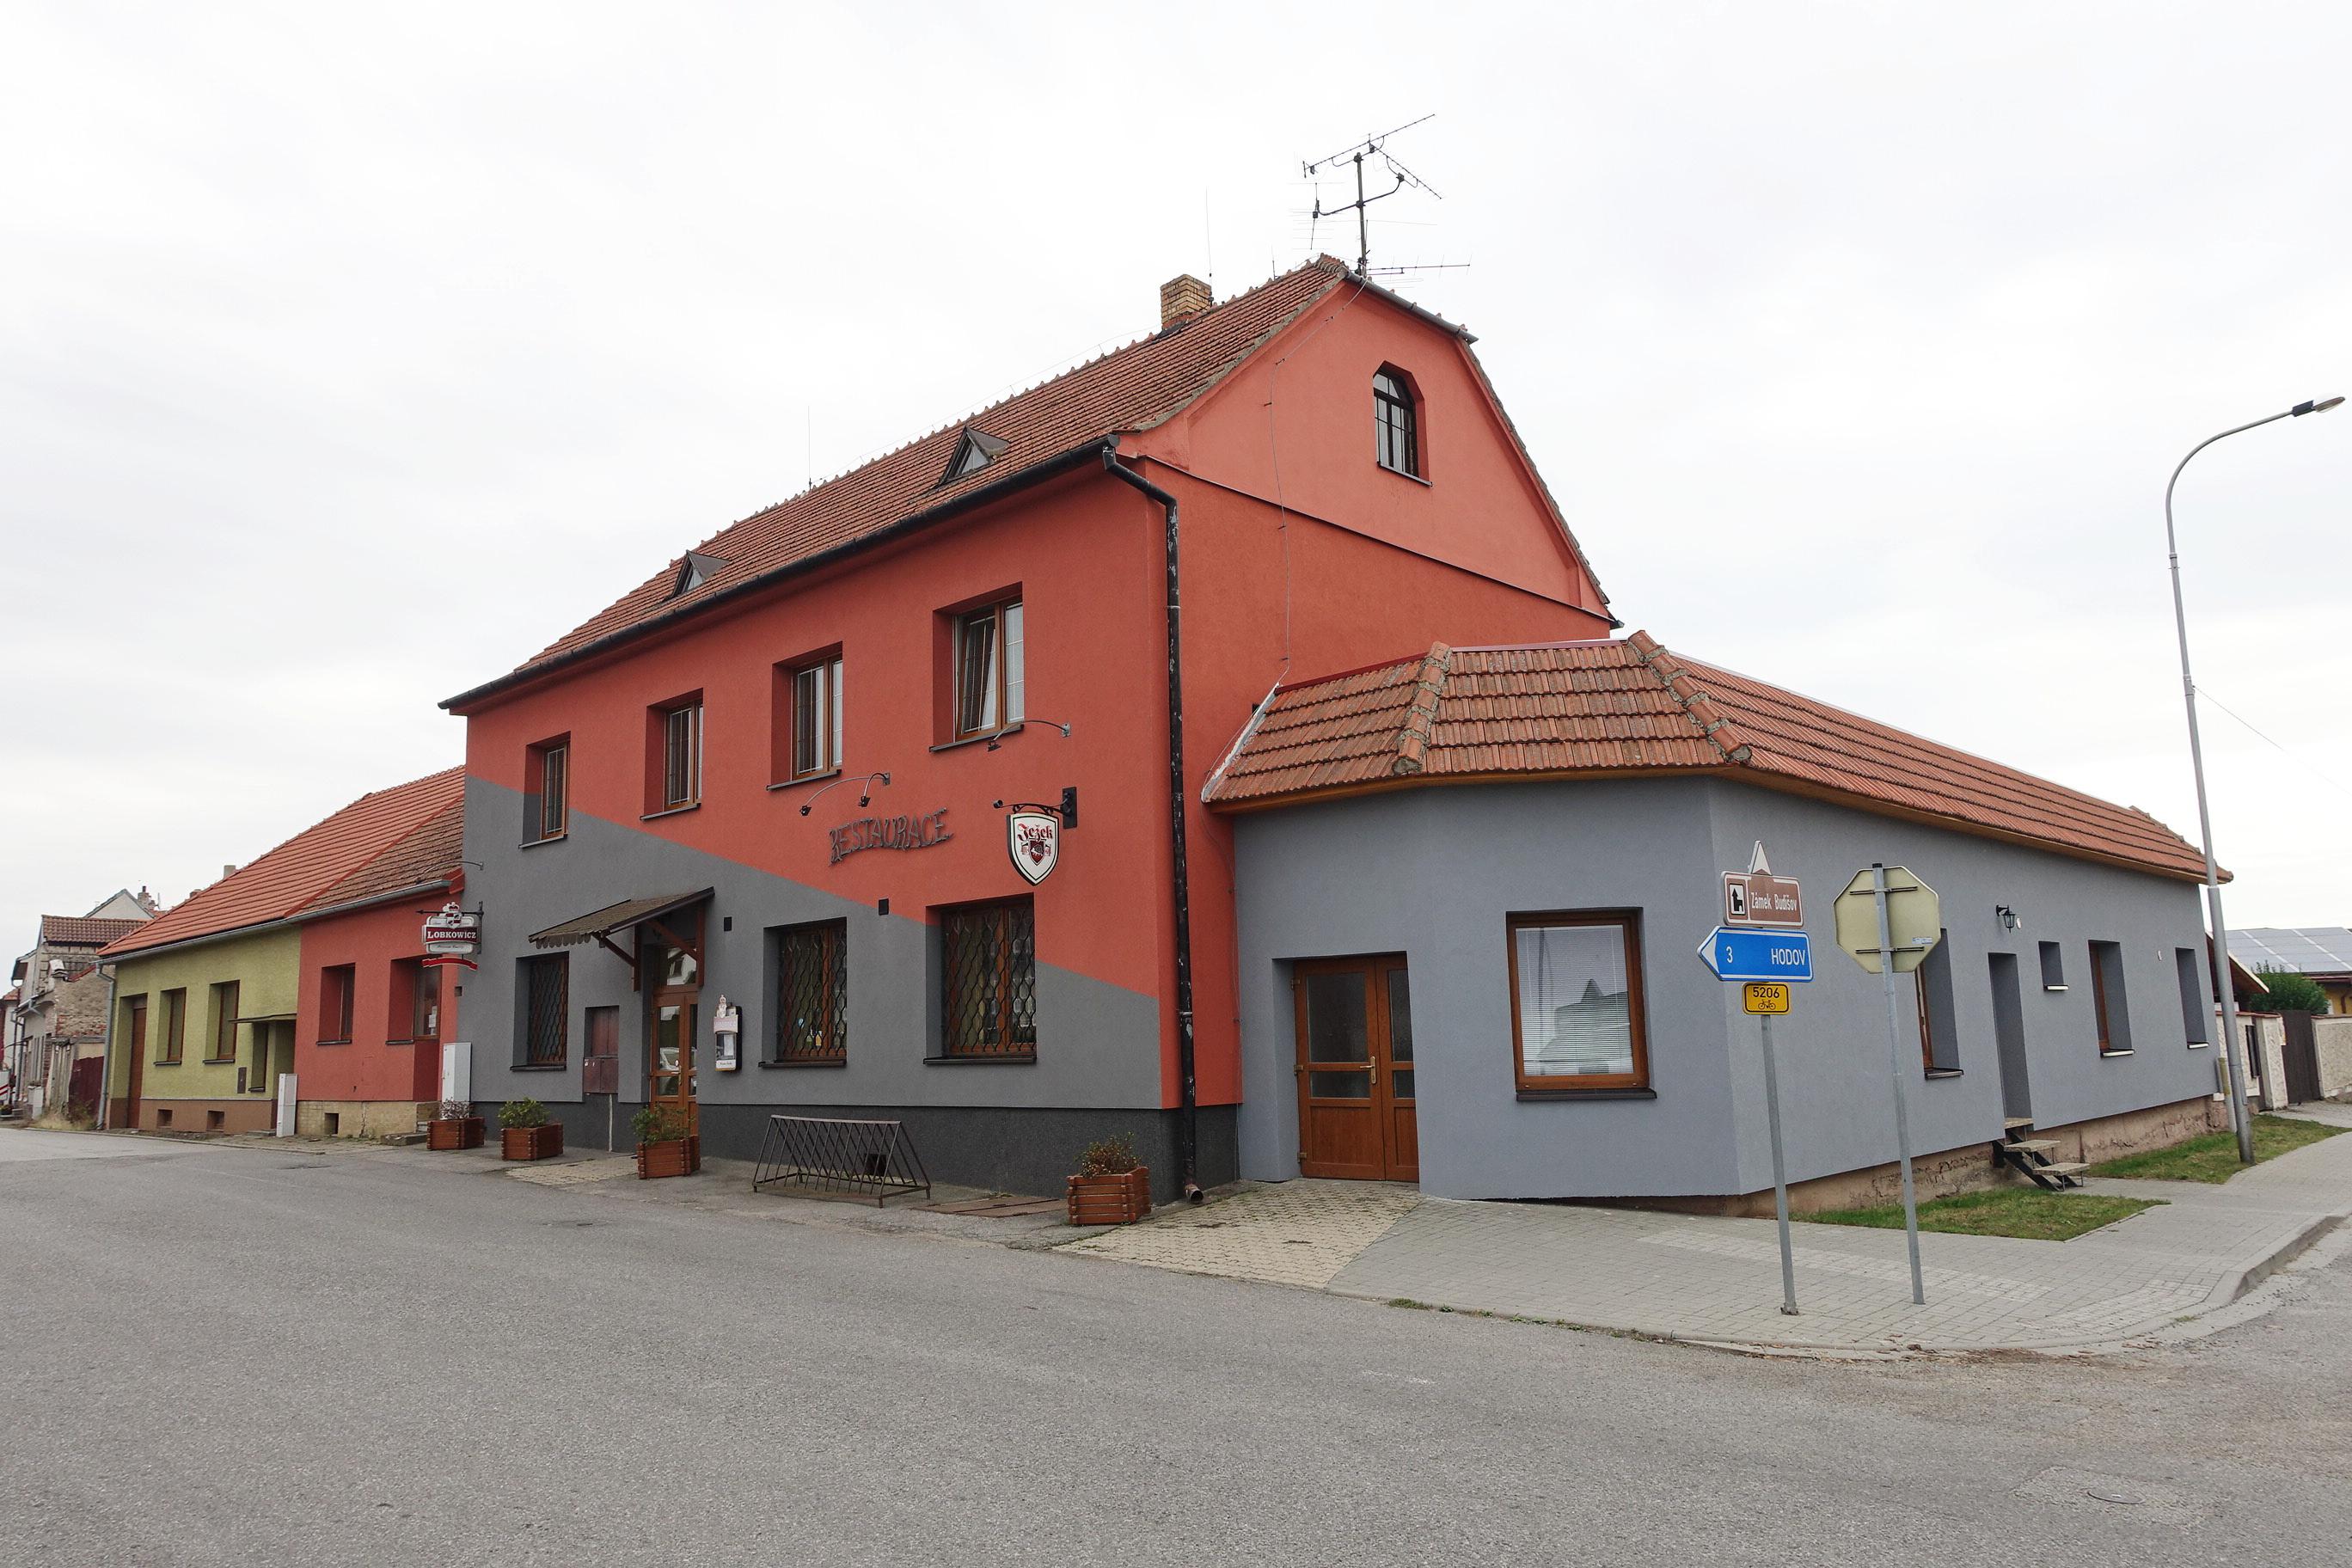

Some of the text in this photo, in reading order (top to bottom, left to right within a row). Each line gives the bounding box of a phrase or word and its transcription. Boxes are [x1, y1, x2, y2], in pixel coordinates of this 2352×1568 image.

[829, 807, 953, 867] RESTAURACE
[1017, 823, 1053, 842] Ježek
[1750, 892, 1772, 910] Zámek
[1725, 946, 1806, 965] 3 HODOV
[1753, 987, 1779, 998] 5206
